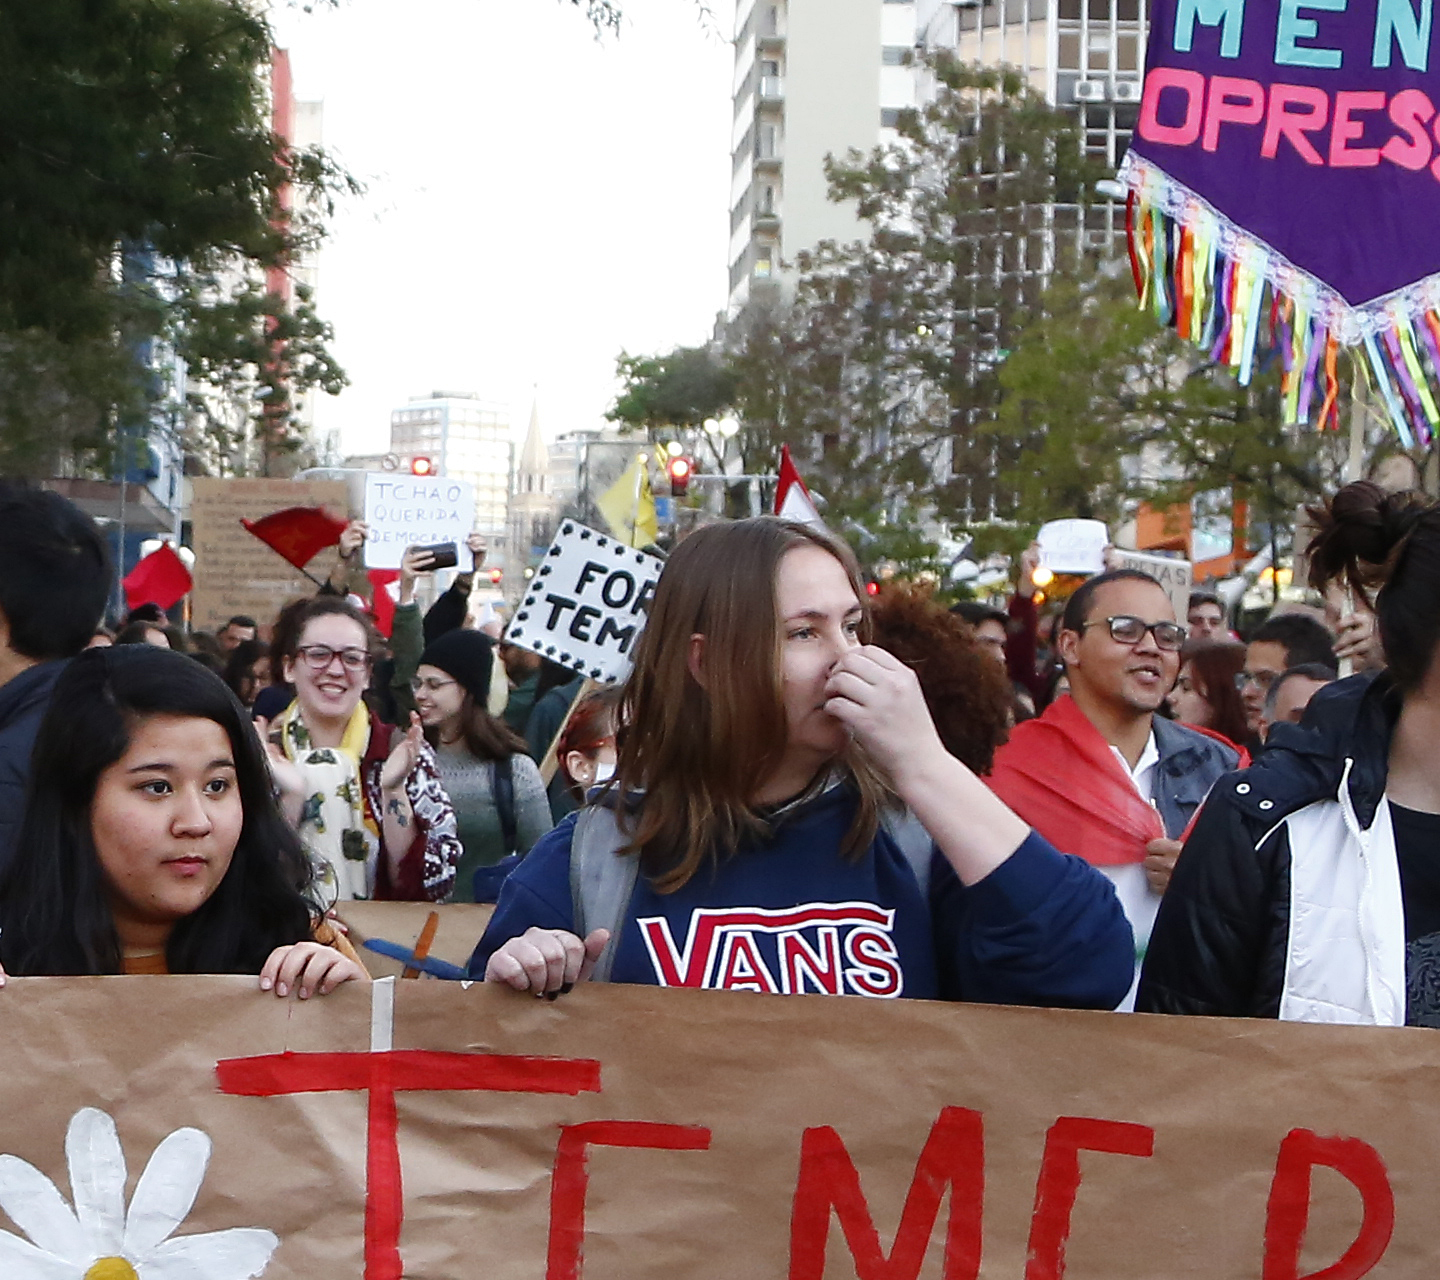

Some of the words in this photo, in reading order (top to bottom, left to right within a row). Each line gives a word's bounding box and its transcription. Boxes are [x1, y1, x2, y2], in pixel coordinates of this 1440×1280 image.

[374, 483, 461, 502] TCHAO
[374, 504, 460, 522] QUERIDA
[636, 902, 903, 999] VANS
